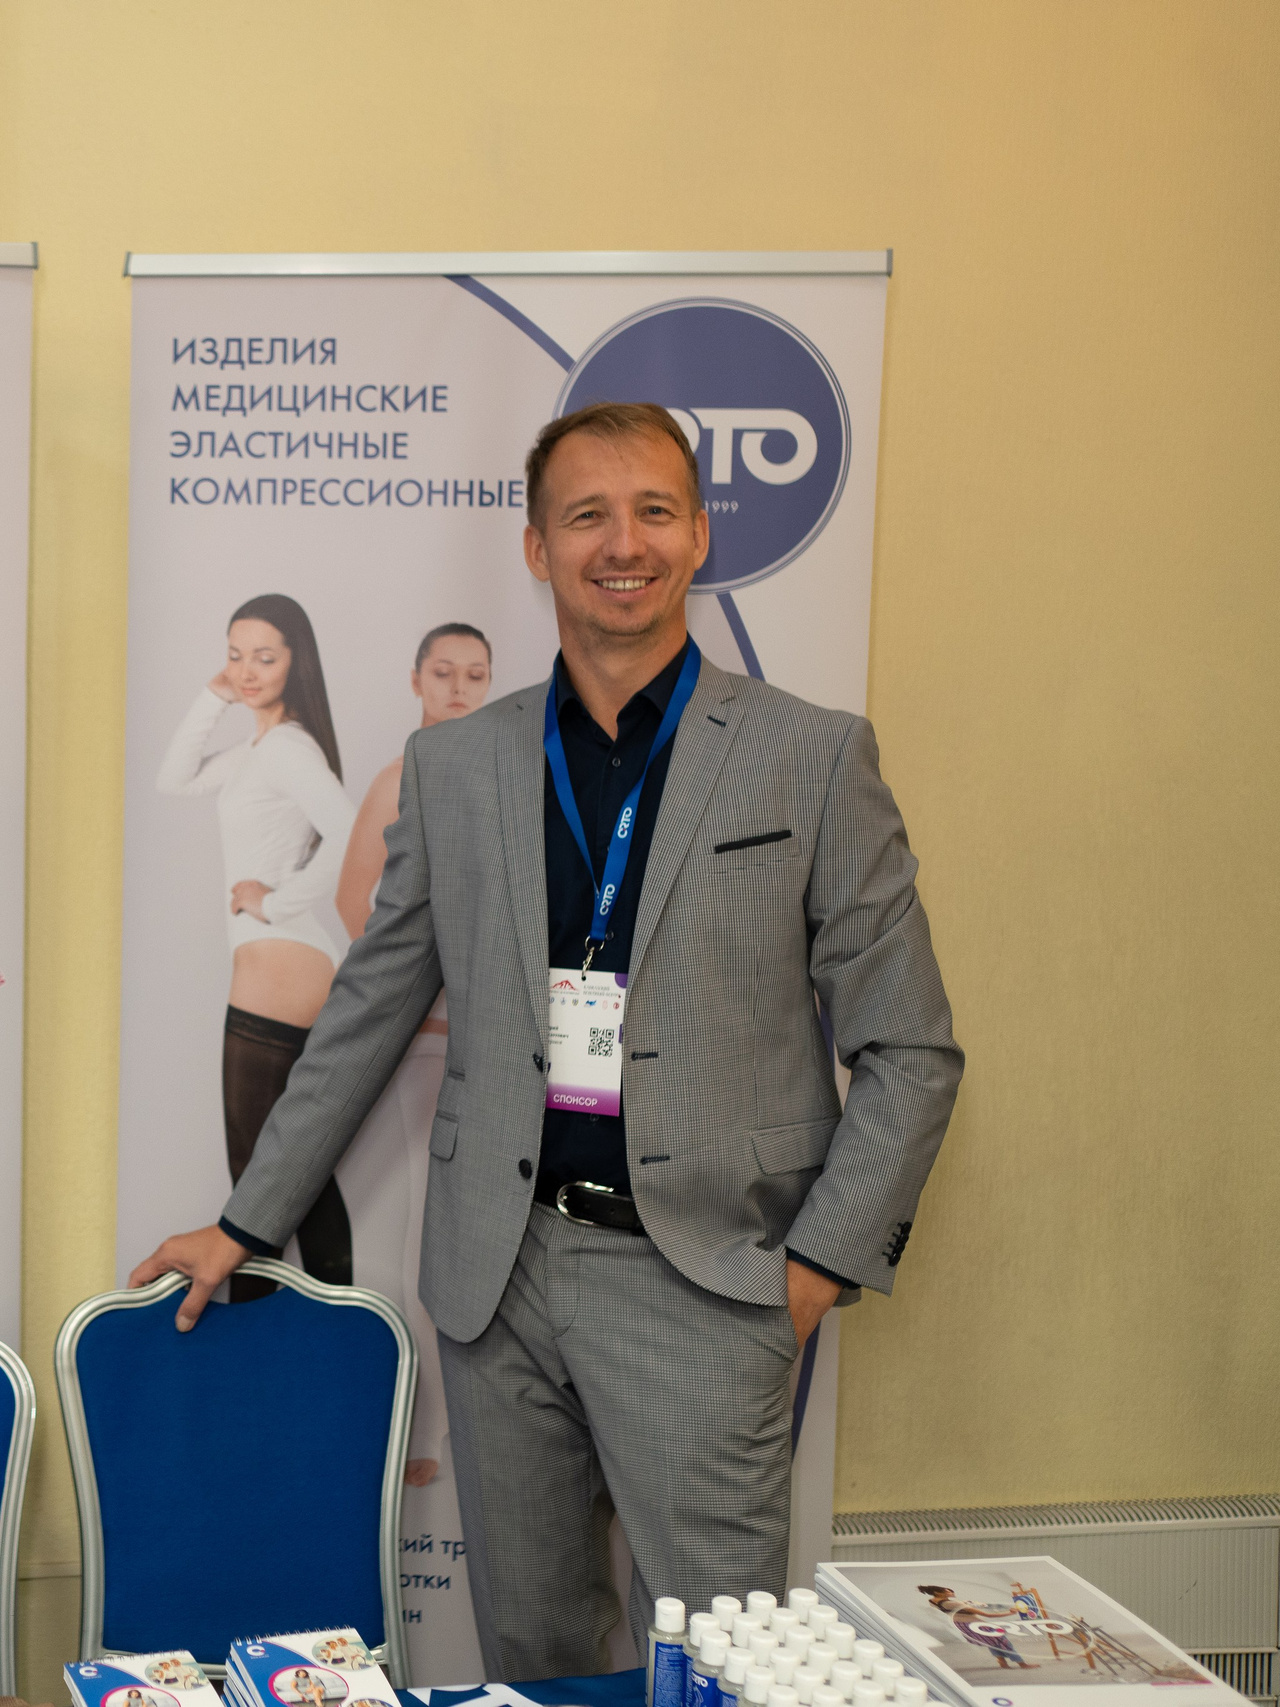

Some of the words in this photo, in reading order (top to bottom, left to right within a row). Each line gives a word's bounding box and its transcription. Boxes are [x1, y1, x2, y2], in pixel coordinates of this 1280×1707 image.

[173, 338, 337, 370] ИЗДЕЛИЯ
[172, 385, 448, 417] МЕДИЦИНСКИЕ
[170, 431, 409, 459] ЭЛАСТИЧНЫЕ
[666, 408, 818, 485] TO
[170, 477, 524, 507] КОМПРЕССИОННЫЕ
[617, 806, 633, 839] ORTO
[599, 883, 616, 916] ORTO
[553, 1093, 598, 1107] СПОНСОР
[969, 1619, 1074, 1637] ORTO
